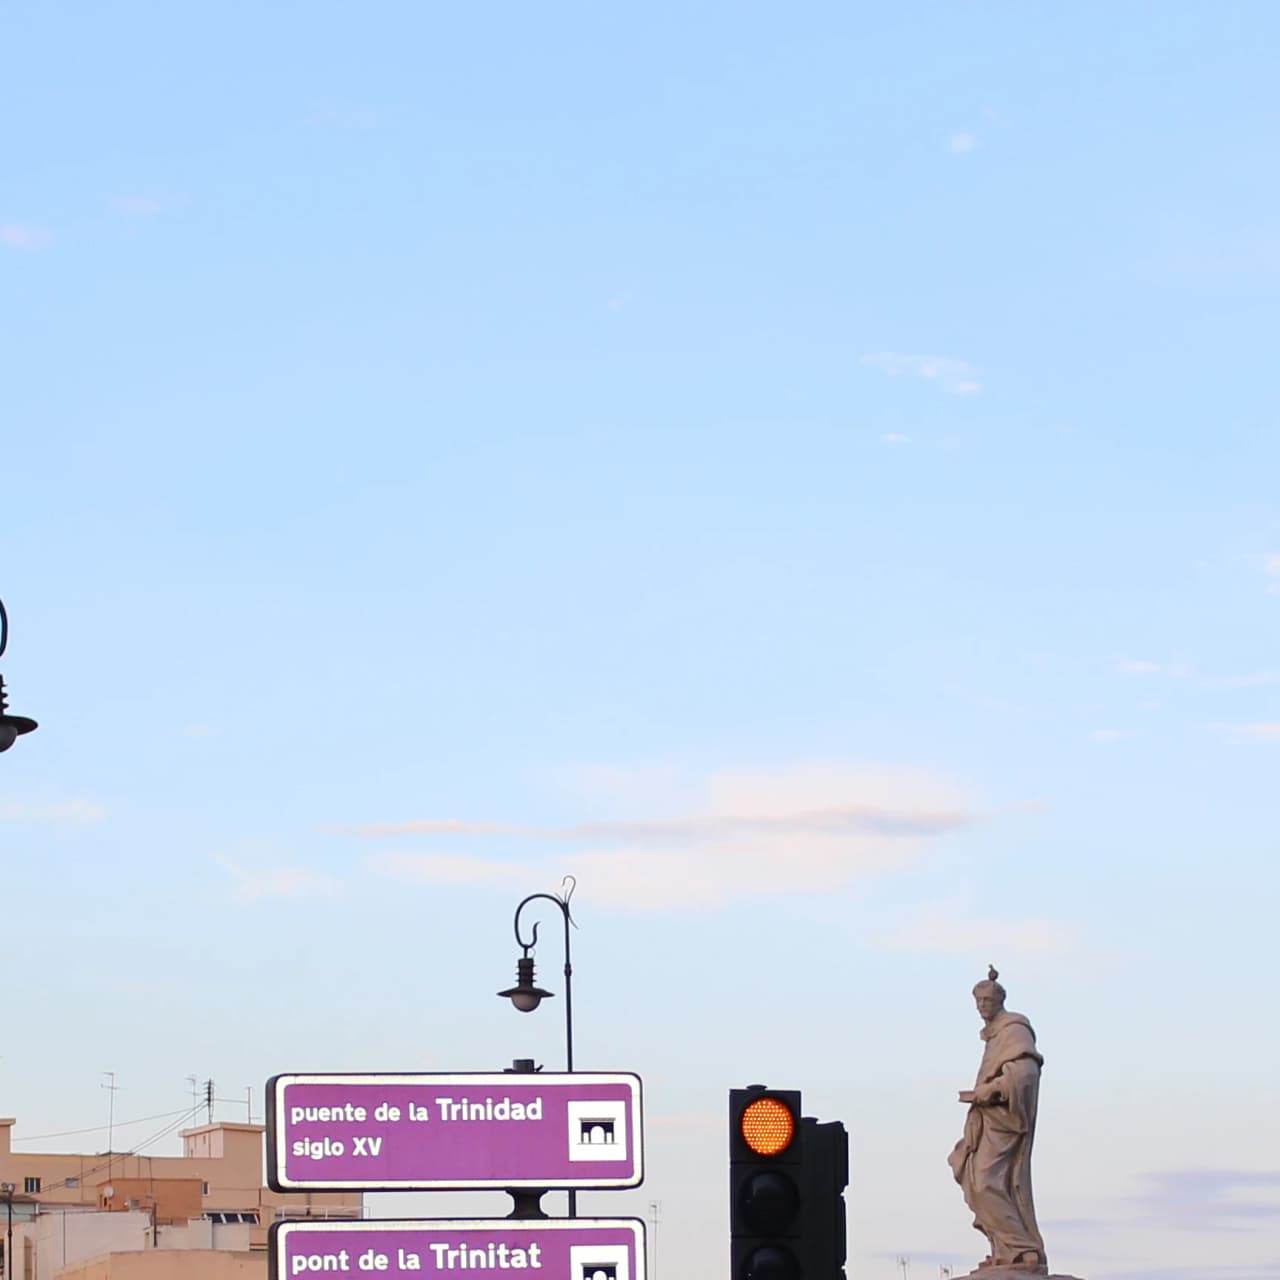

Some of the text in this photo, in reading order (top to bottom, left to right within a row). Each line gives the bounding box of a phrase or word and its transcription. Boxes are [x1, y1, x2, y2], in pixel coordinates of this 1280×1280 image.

[291, 1097, 543, 1125] puente de la Trinidad
[292, 1136, 383, 1160] siglo XV
[291, 1242, 542, 1276] pont de la Trinitat
